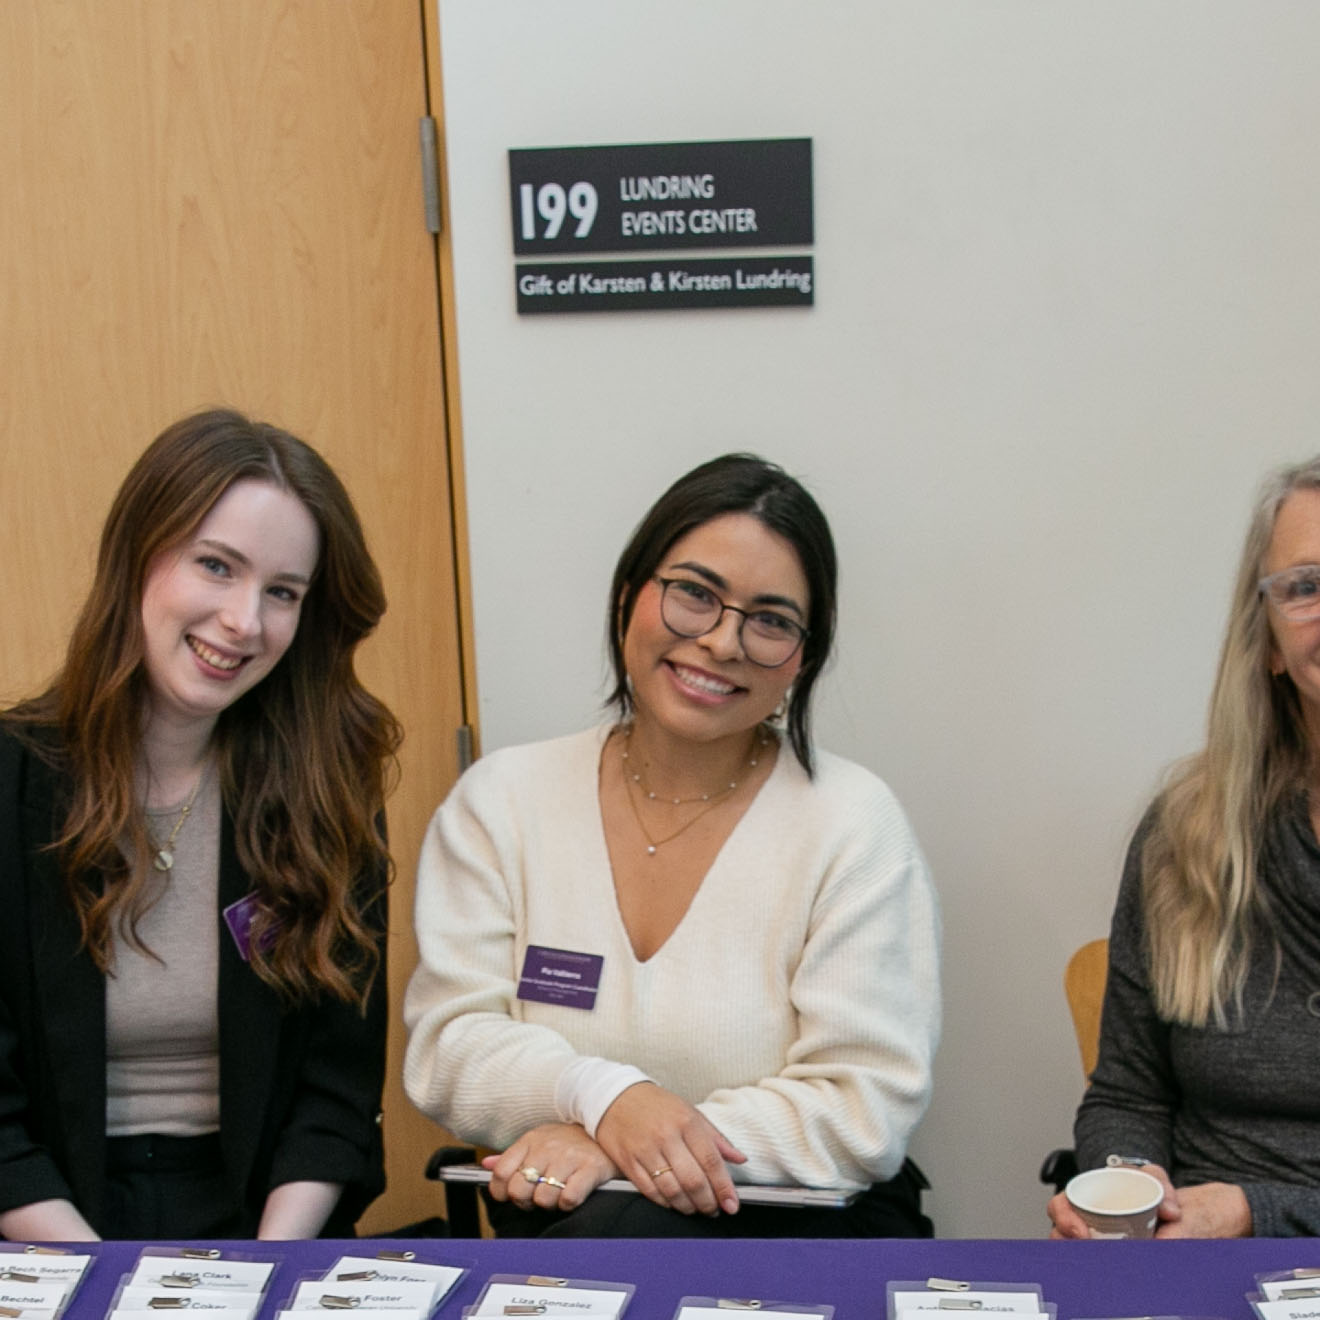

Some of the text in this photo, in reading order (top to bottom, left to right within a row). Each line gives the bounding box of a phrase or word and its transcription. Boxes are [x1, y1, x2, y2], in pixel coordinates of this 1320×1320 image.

[620, 174, 715, 202] LUNDRING
[519, 182, 599, 240] 199
[622, 207, 758, 237] EVENTS CENTER
[519, 269, 811, 295] Gift of Karsten & Kirsten Lundring
